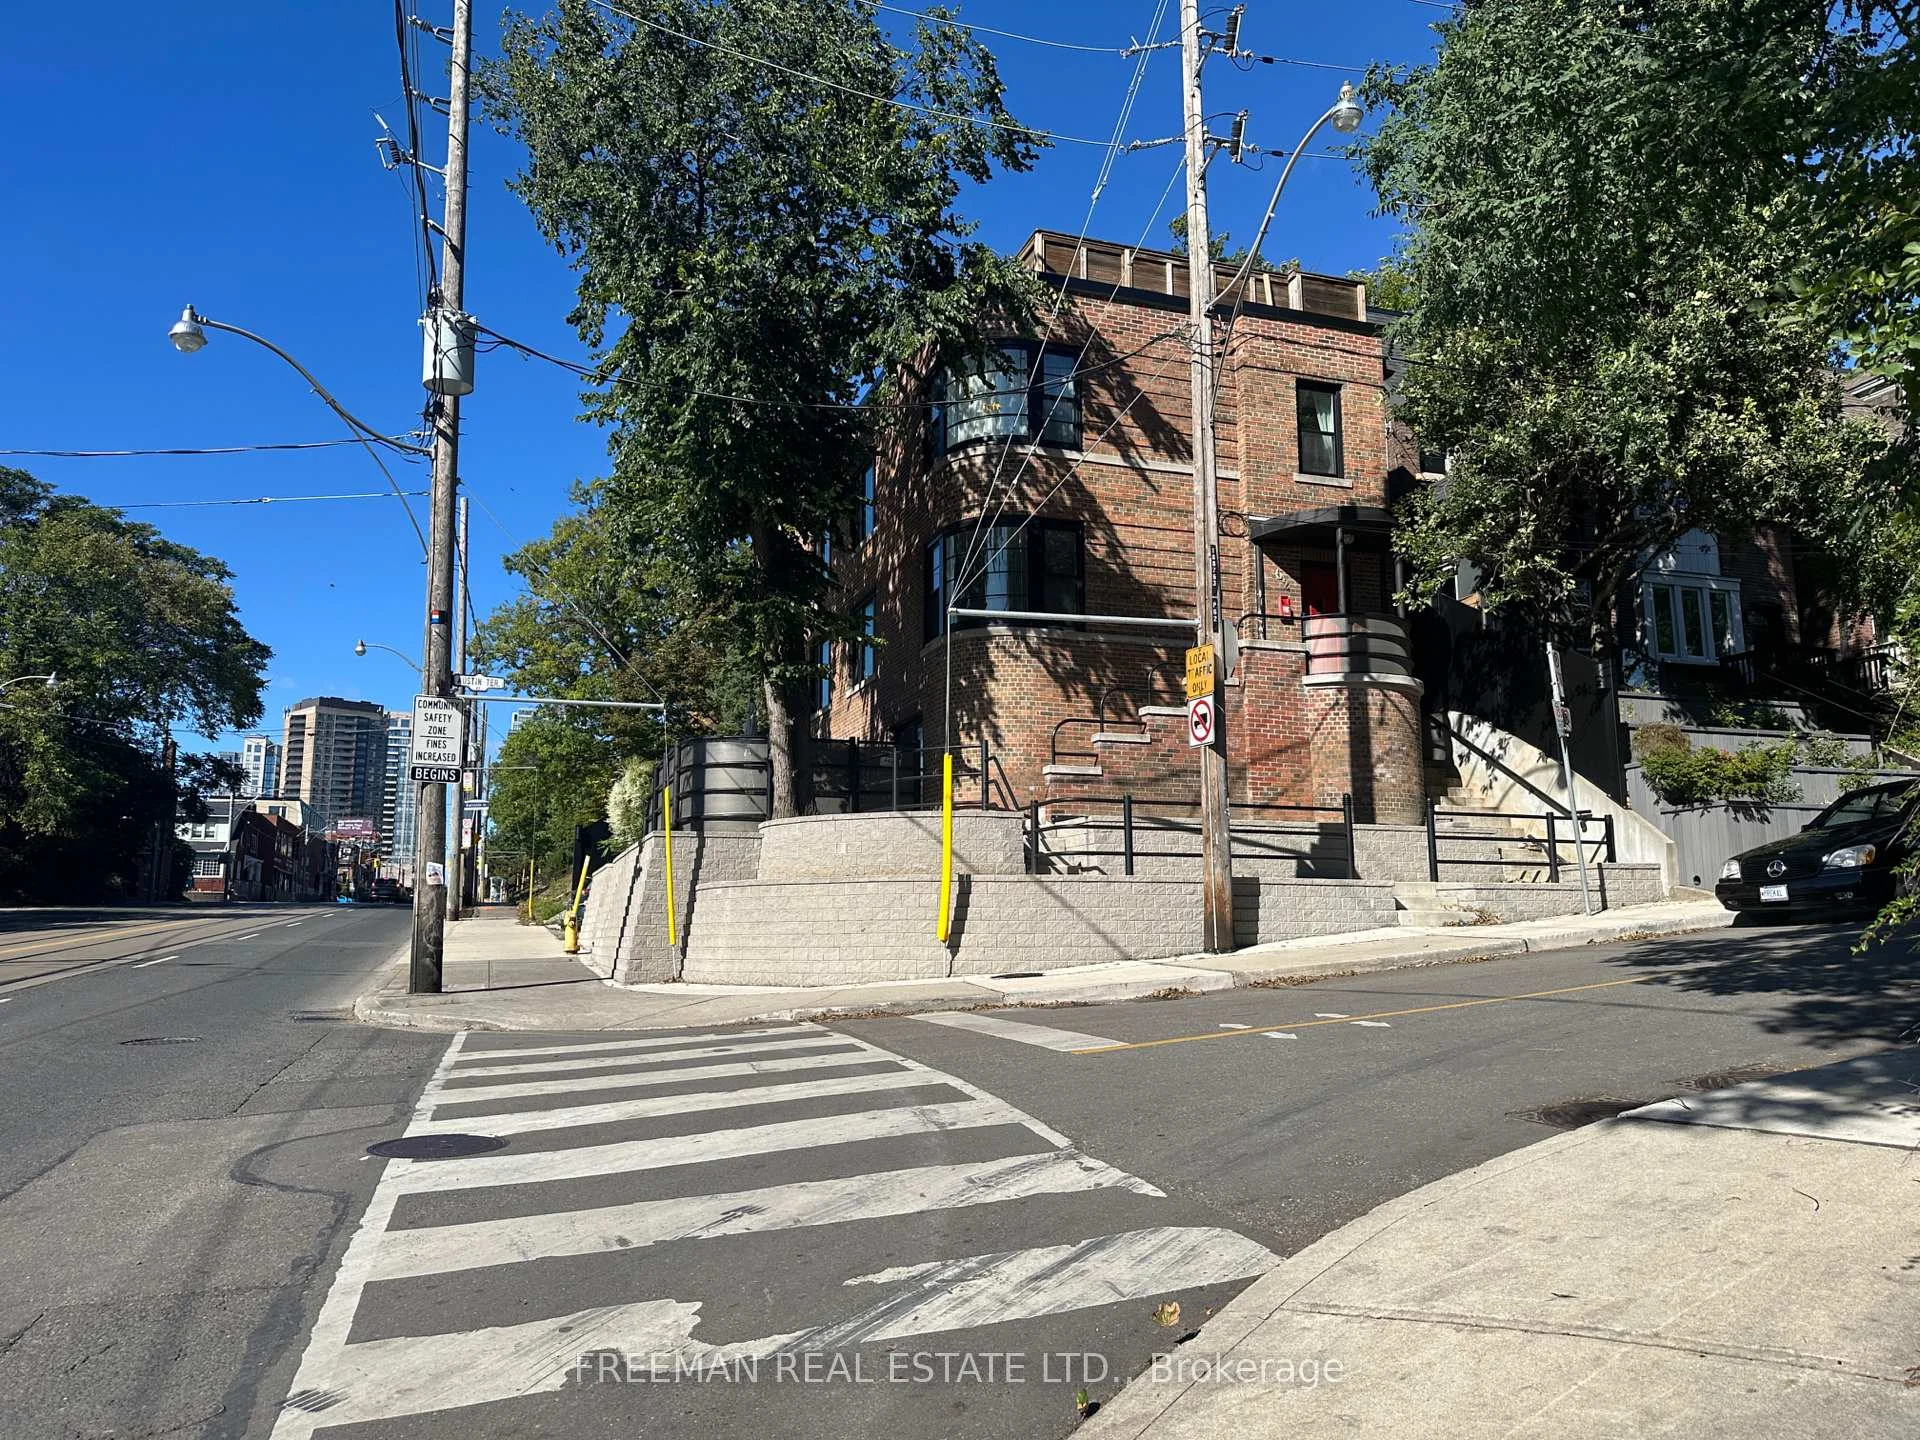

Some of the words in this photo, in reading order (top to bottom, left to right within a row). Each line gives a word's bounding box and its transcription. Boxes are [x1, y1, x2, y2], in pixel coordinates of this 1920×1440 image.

[1188, 663, 1213, 678] TAFFIC
[1192, 680, 1208, 694] ONLY
[417, 699, 460, 711] COMMUNITY
[424, 712, 453, 724] SAFETY
[427, 725, 448, 736] ZONE
[426, 739, 448, 749] FINES
[415, 751, 457, 762] INCREASED
[415, 767, 457, 781] BEGINS
